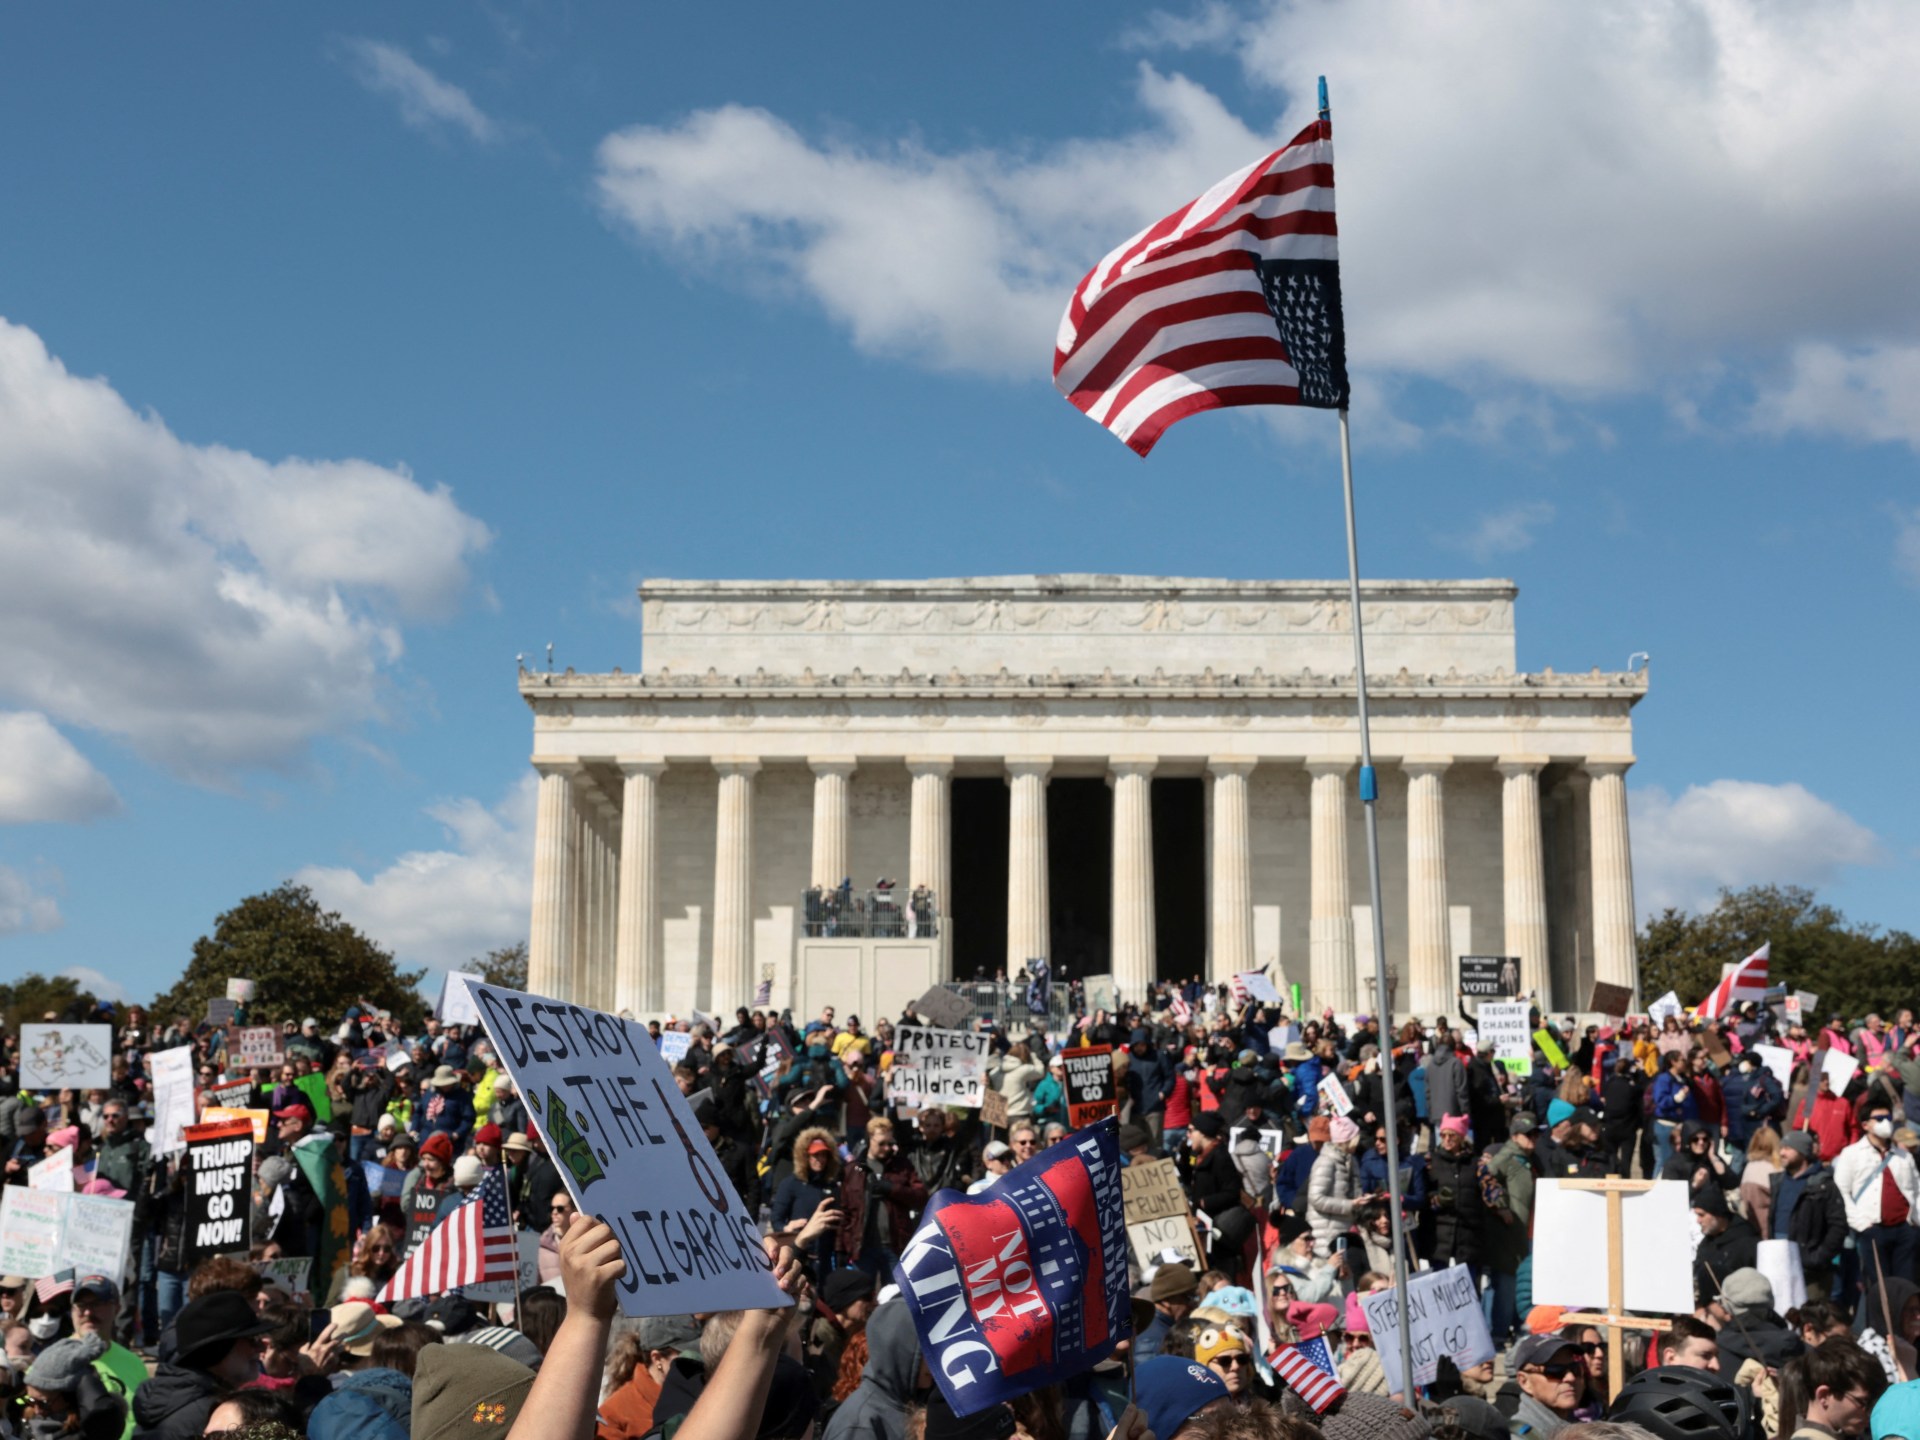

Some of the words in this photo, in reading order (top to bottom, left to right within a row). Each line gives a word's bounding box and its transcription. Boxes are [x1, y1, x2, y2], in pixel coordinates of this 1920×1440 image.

[1461, 981, 1498, 993] VOTE!
[1482, 1020, 1525, 1030] CHANGE
[1484, 1006, 1523, 1016] REGIME
[478, 988, 642, 1069] DESTROY
[899, 1028, 987, 1056] PROTECT
[921, 1055, 953, 1070] THE
[1064, 1053, 1112, 1073] TRUMP
[892, 1067, 979, 1095] Children
[1070, 1069, 1109, 1088] MUST
[1081, 1085, 1103, 1102] GO
[562, 1075, 666, 1159] THE
[189, 1139, 252, 1170] TRUMP
[195, 1165, 245, 1195] MUST
[207, 1193, 234, 1220] GO
[415, 1194, 436, 1210] NO
[1105, 1161, 1124, 1236] NOT
[1123, 1188, 1180, 1217] TRUMP
[195, 1218, 244, 1248] NOW!
[1075, 1135, 1117, 1341] PRESIDENT
[1143, 1218, 1179, 1245] NO
[992, 1227, 1049, 1319] NOT
[1113, 1239, 1127, 1292] MY
[964, 1254, 1013, 1324] MY
[1432, 1275, 1478, 1314] MILLER
[899, 1219, 999, 1391] KING
[1443, 1325, 1468, 1354] GO
